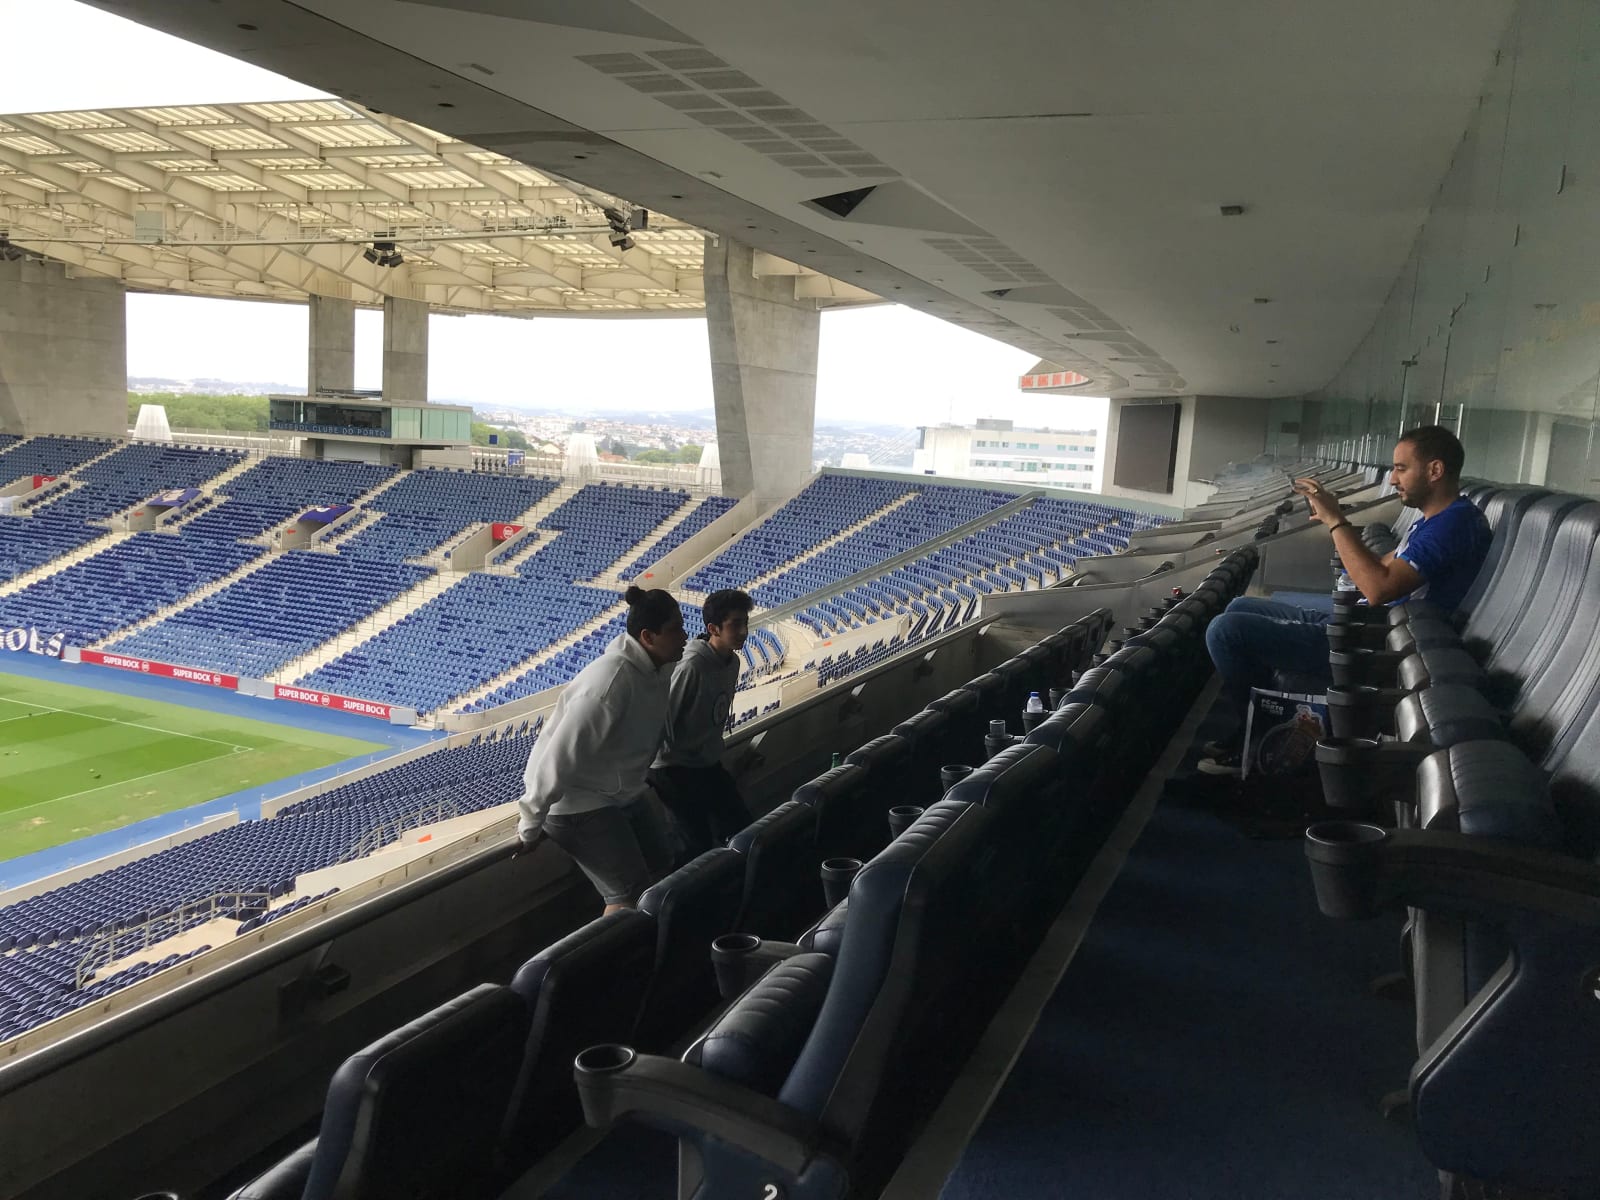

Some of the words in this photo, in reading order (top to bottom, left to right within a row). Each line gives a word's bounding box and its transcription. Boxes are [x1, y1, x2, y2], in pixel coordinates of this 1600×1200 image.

[273, 422, 310, 432] FUTEBOL
[312, 425, 339, 434] CLUBE
[342, 427, 354, 435] DO
[357, 428, 386, 437] PORTO
[103, 656, 122, 666] SUPER
[122, 659, 140, 669] BOCK
[173, 668, 193, 679] SUPER
[193, 672, 211, 682] BOCK
[278, 688, 299, 699] SUPER
[299, 692, 319, 703] BOCK
[343, 700, 364, 711] SUPER
[365, 704, 386, 716] BOCK
